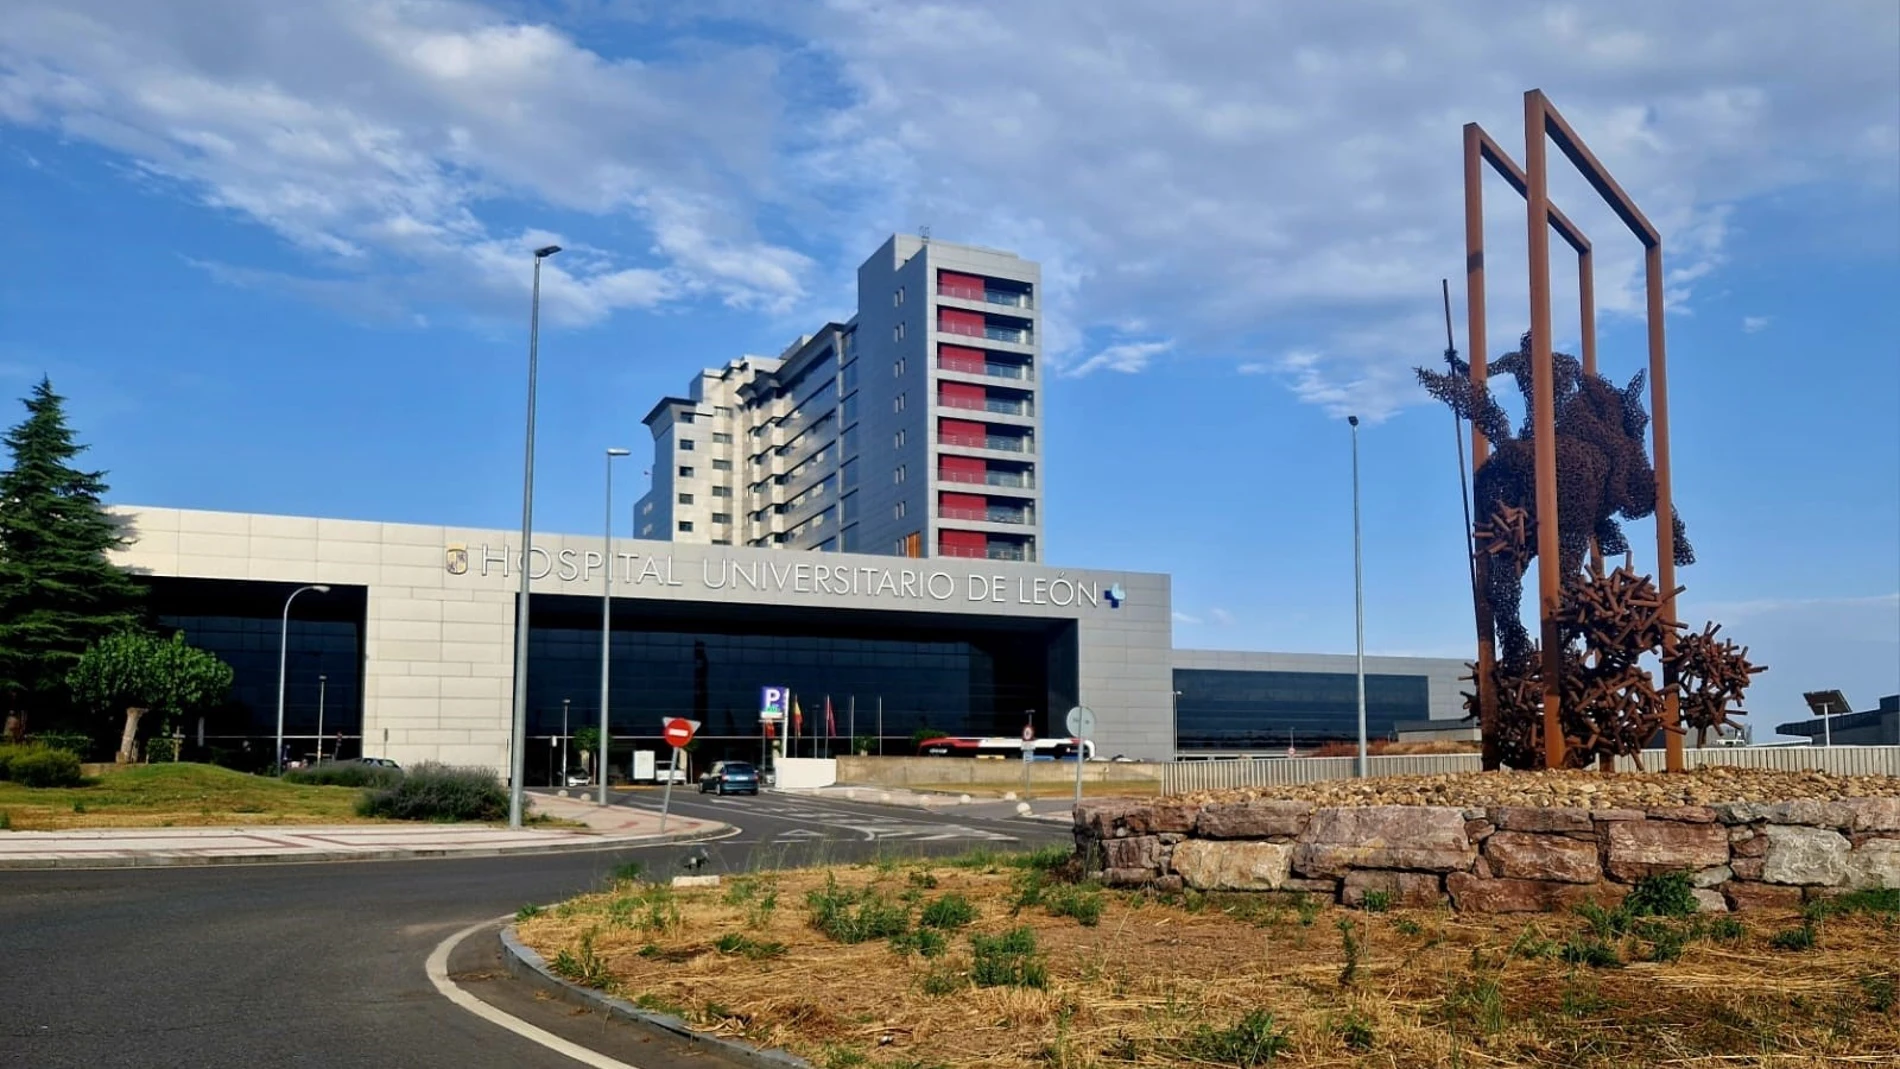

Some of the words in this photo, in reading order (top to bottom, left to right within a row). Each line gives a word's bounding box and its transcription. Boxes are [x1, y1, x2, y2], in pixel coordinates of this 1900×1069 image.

[482, 544, 683, 586] HOSPITAL
[703, 558, 954, 600] UNIVERSITARIO
[968, 574, 1006, 602] DE
[1018, 571, 1097, 607] LEÓN
[766, 689, 780, 708] P
